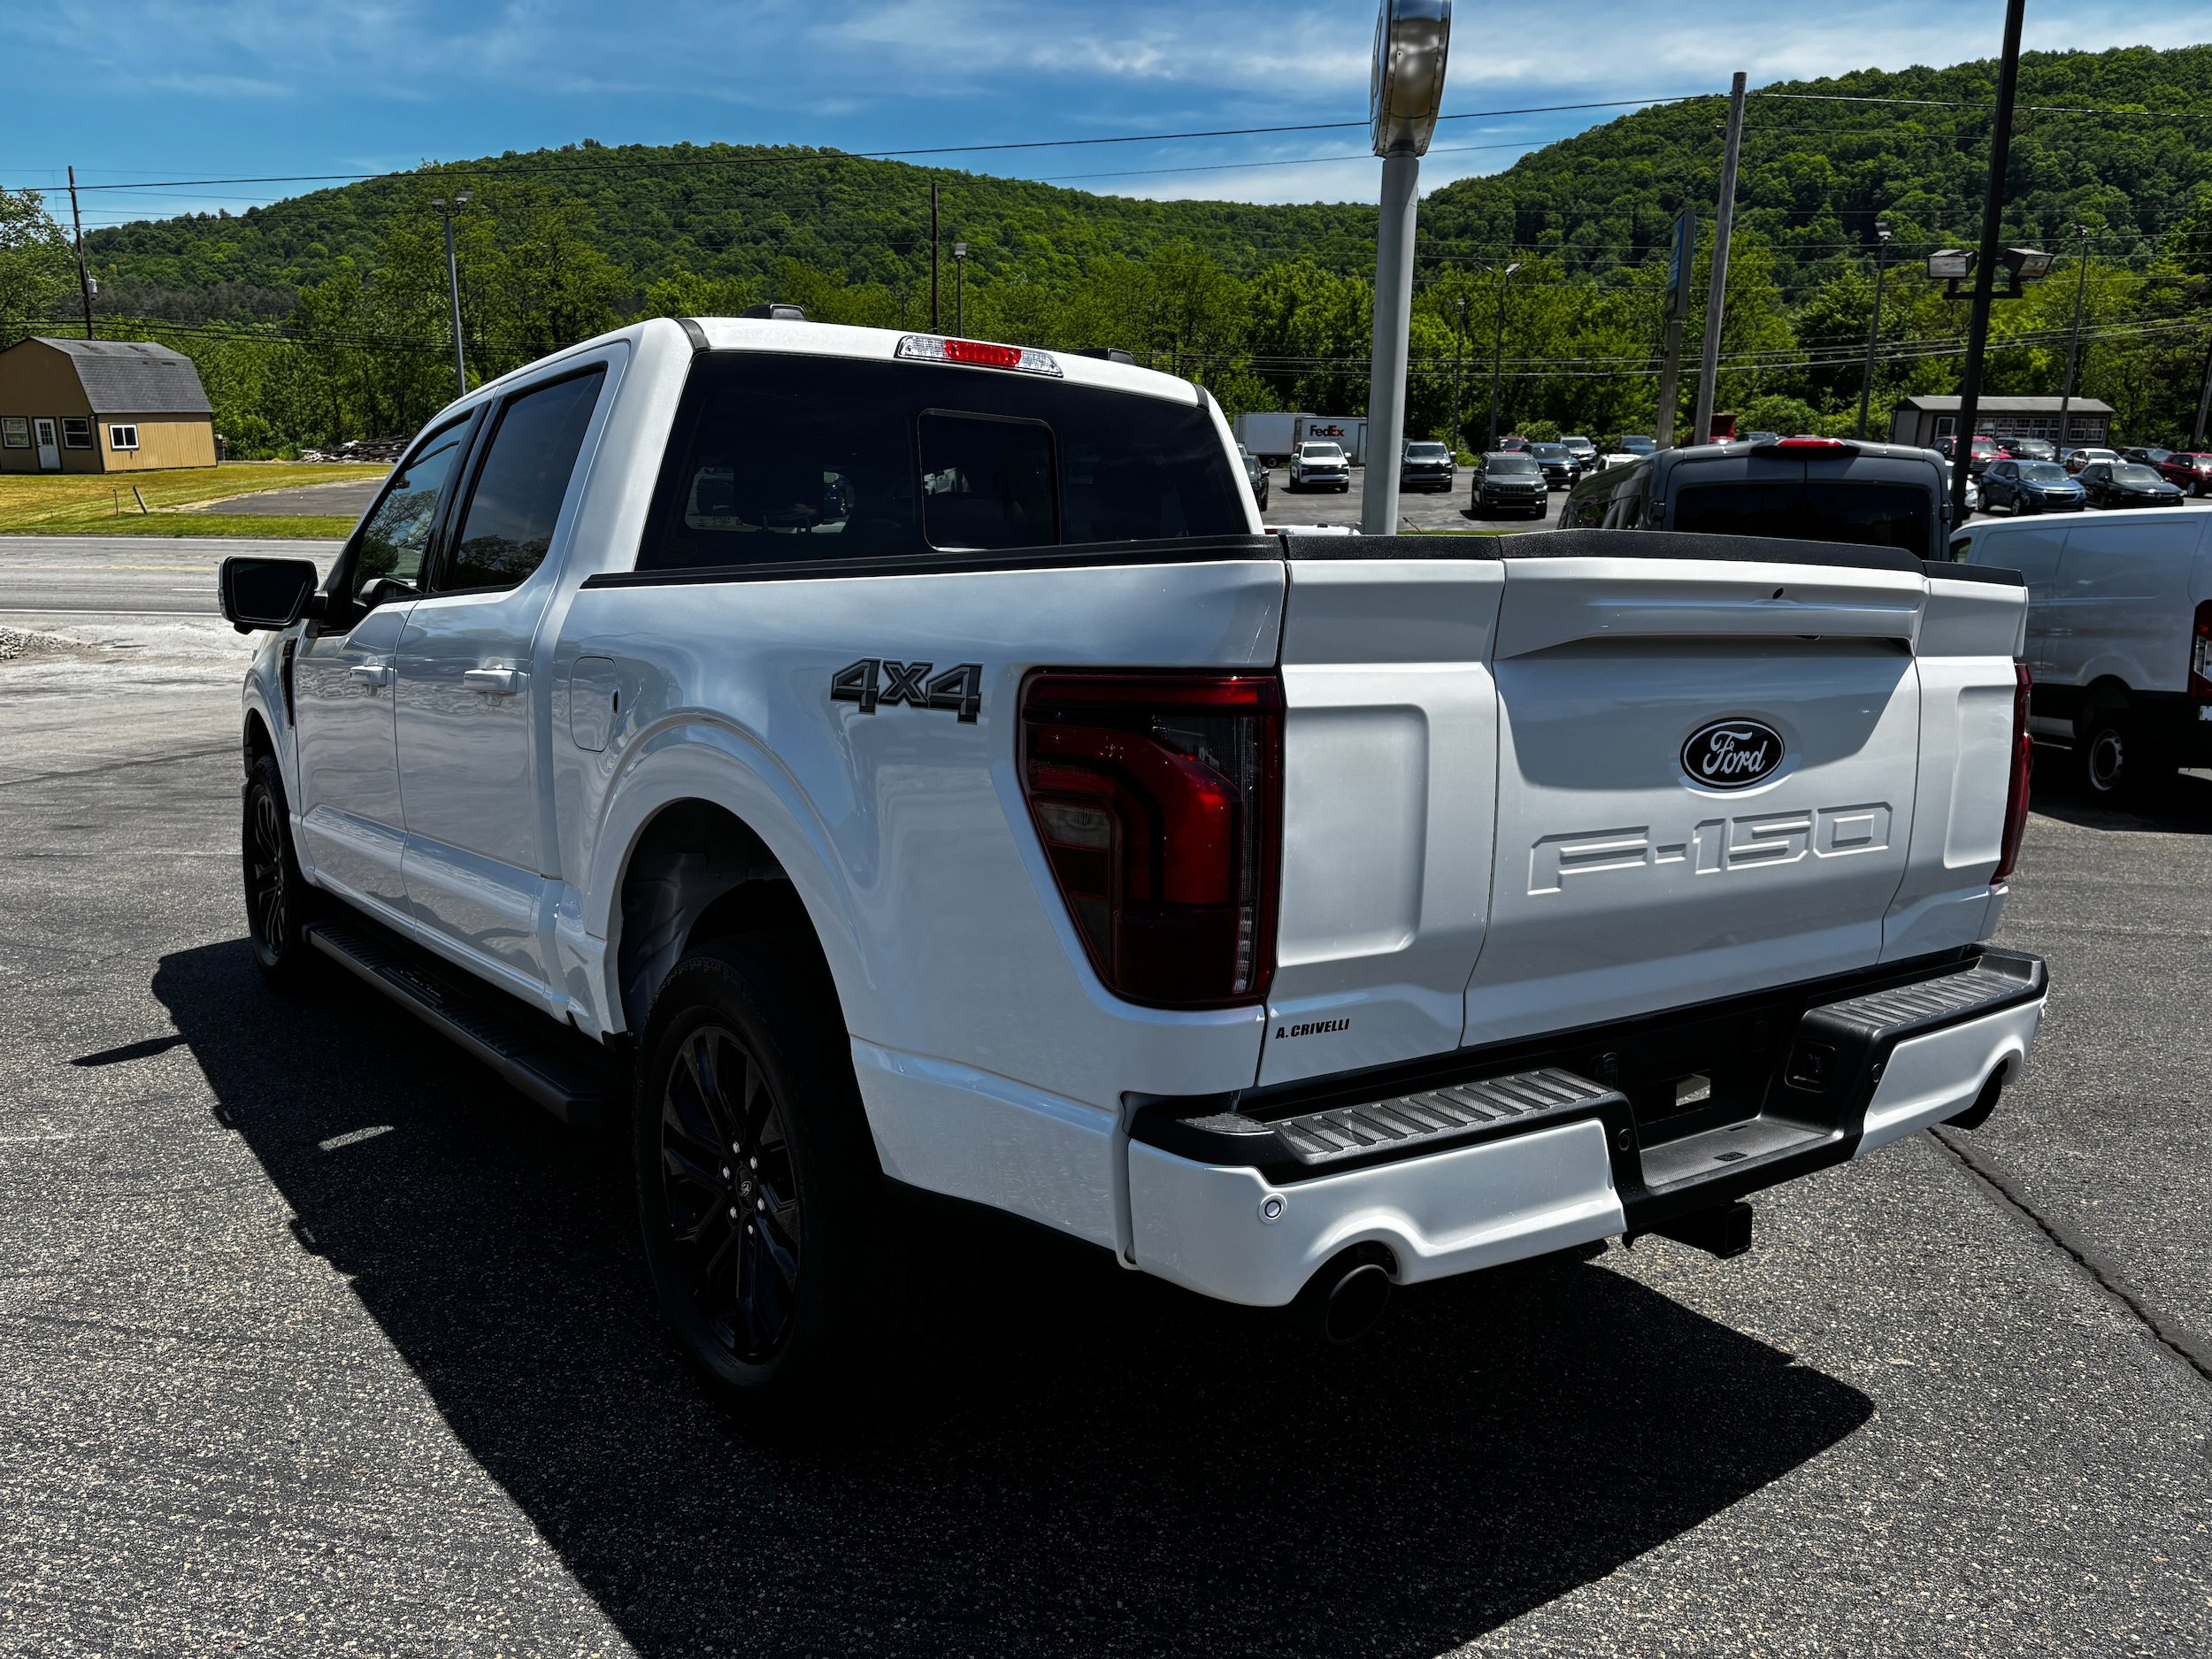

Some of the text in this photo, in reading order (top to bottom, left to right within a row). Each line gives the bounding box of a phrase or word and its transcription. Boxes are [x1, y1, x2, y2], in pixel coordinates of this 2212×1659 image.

[1310, 425, 1345, 437] FedEx
[1702, 730, 1768, 775] Ford
[1527, 802, 1893, 895] F-150
[1290, 1018, 1349, 1038] CRIVELLI
